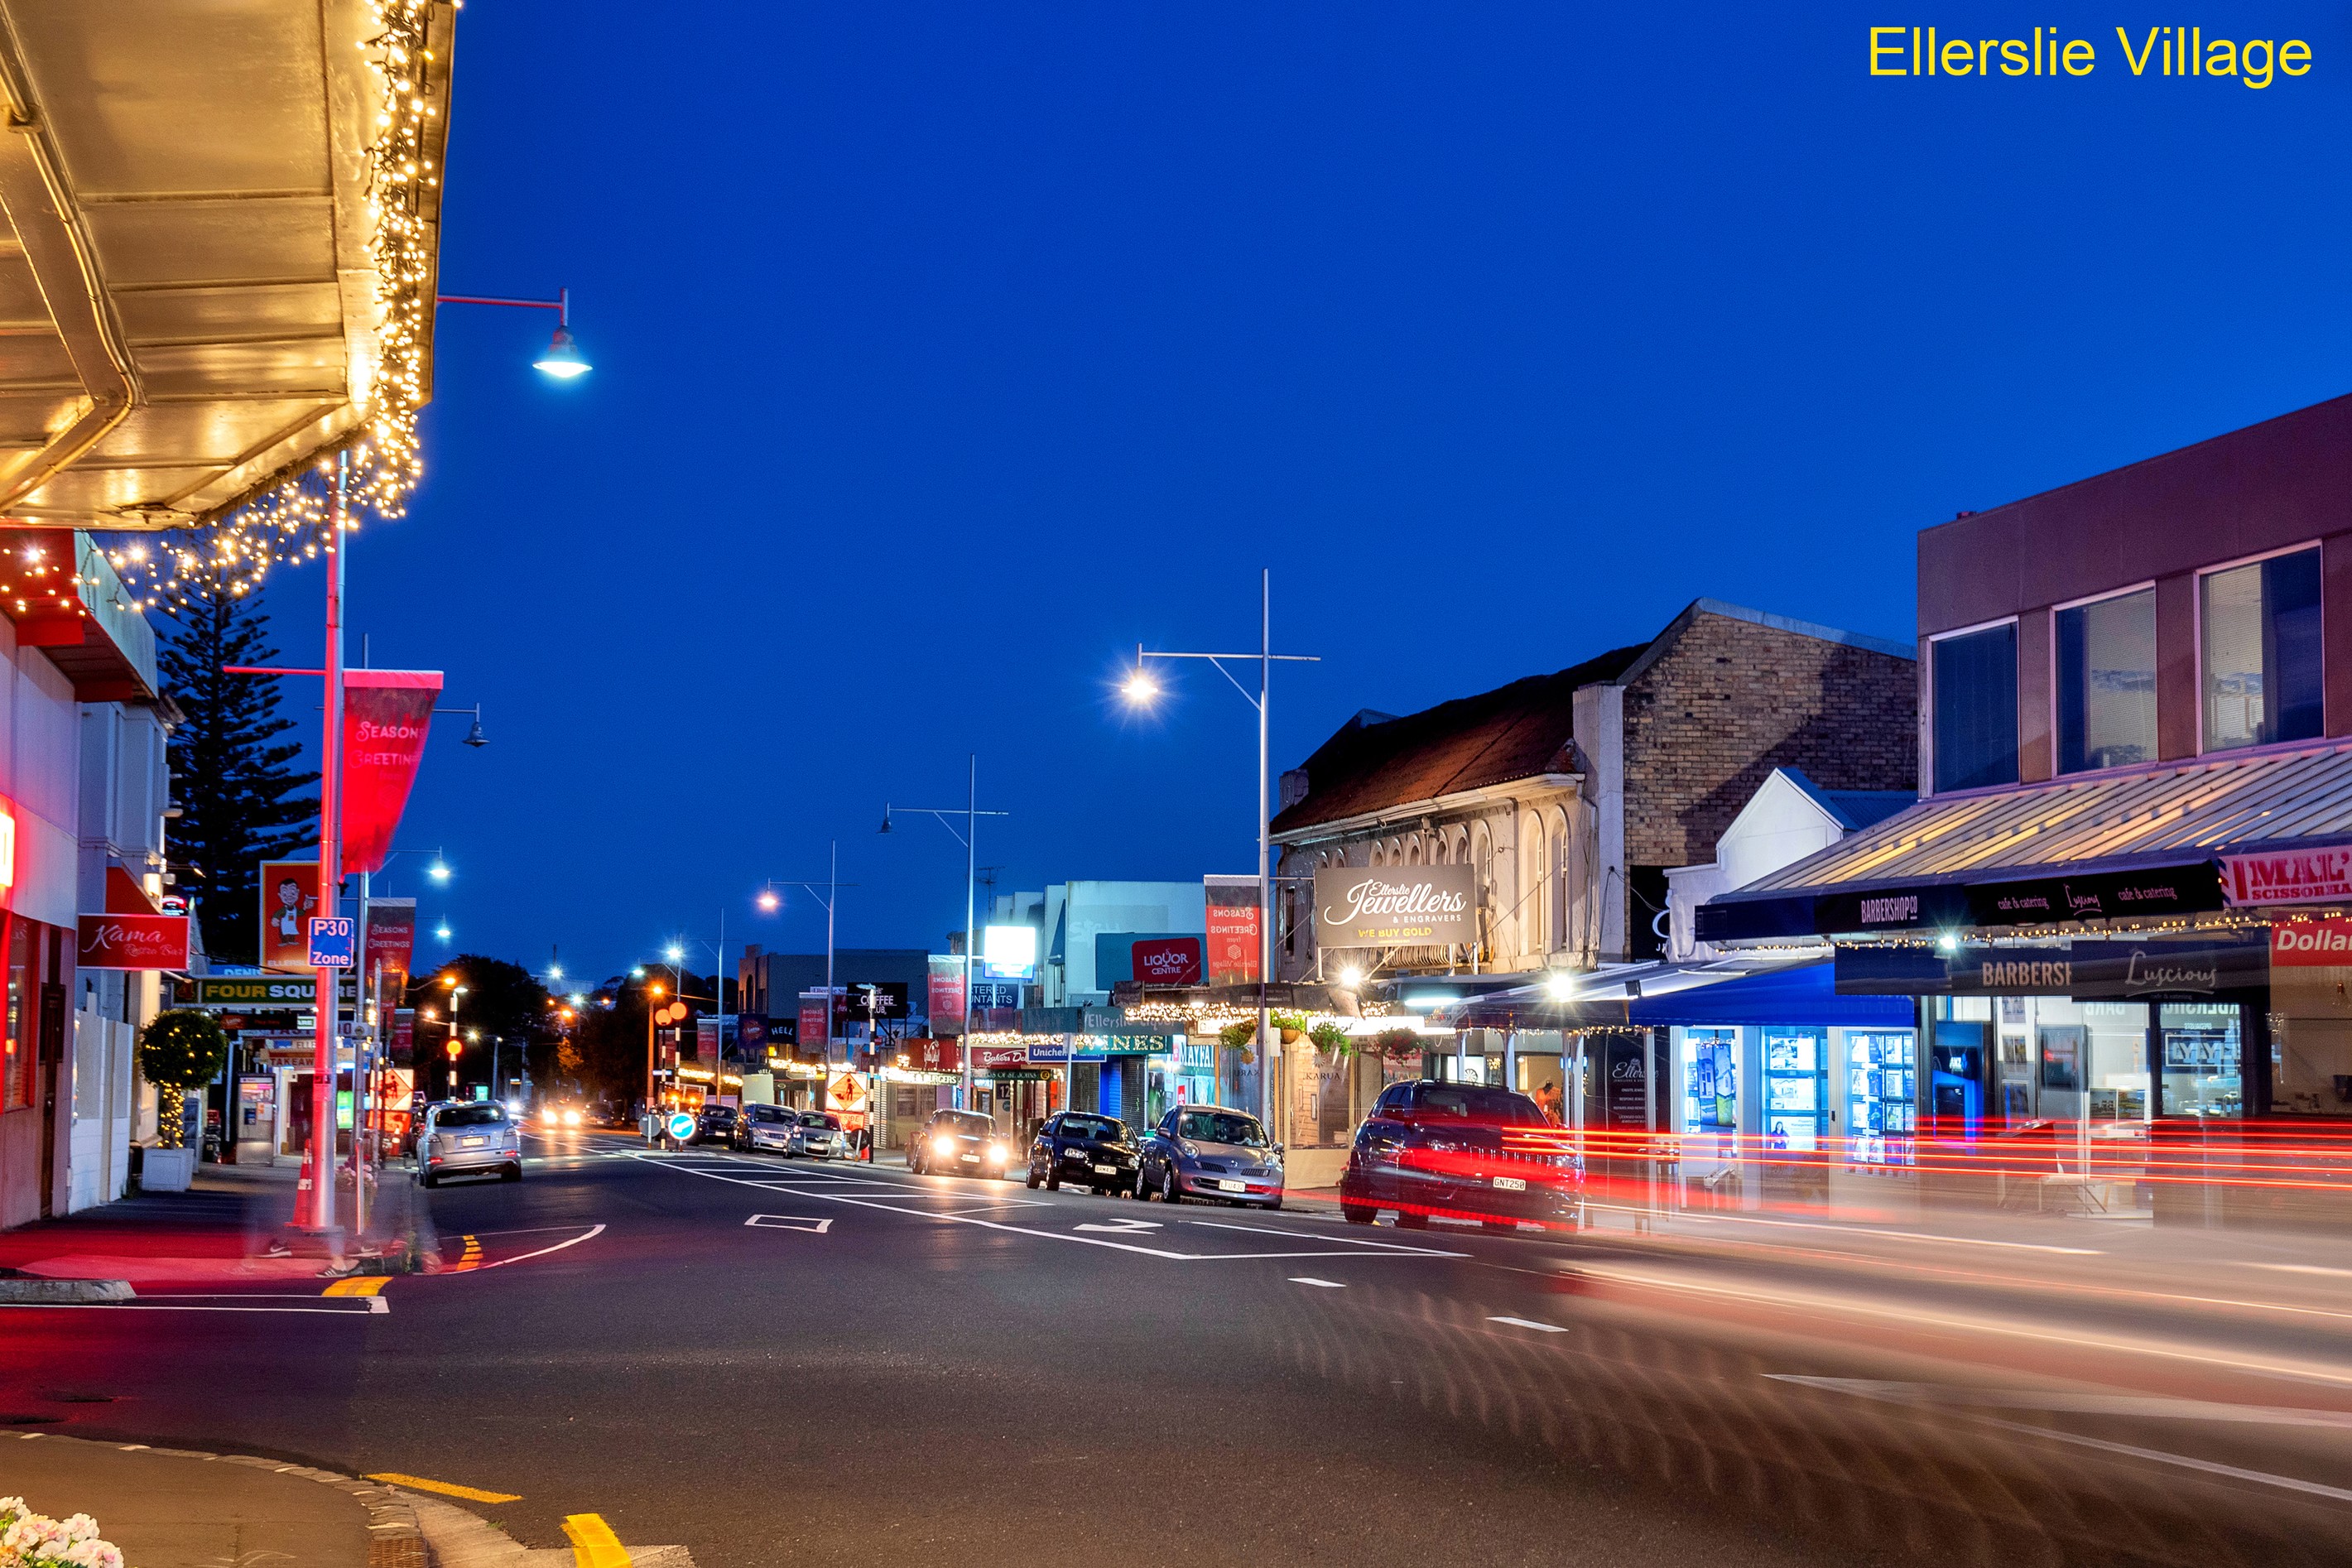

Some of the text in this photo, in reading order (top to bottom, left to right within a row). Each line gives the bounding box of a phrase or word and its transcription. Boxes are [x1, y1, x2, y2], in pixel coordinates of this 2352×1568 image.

[1368, 881, 1411, 897] Ellerslie
[2118, 885, 2177, 901] cafe & catering
[1324, 878, 1467, 925] Jewellers
[1998, 895, 2050, 910] cafe & catering
[1392, 914, 1462, 924] & ENGRAVERS
[314, 920, 349, 936] P30
[1358, 926, 1432, 938] WE BUY GOLD
[312, 951, 349, 964] Zone
[1143, 953, 1189, 968] LIQUOR
[1152, 966, 1181, 975] CENTRE
[206, 985, 357, 999] FOUR SQURE
[771, 1026, 793, 1036] HELL
[1220, 1181, 1245, 1190] LFU432
[1494, 1178, 1525, 1190] GNT250
